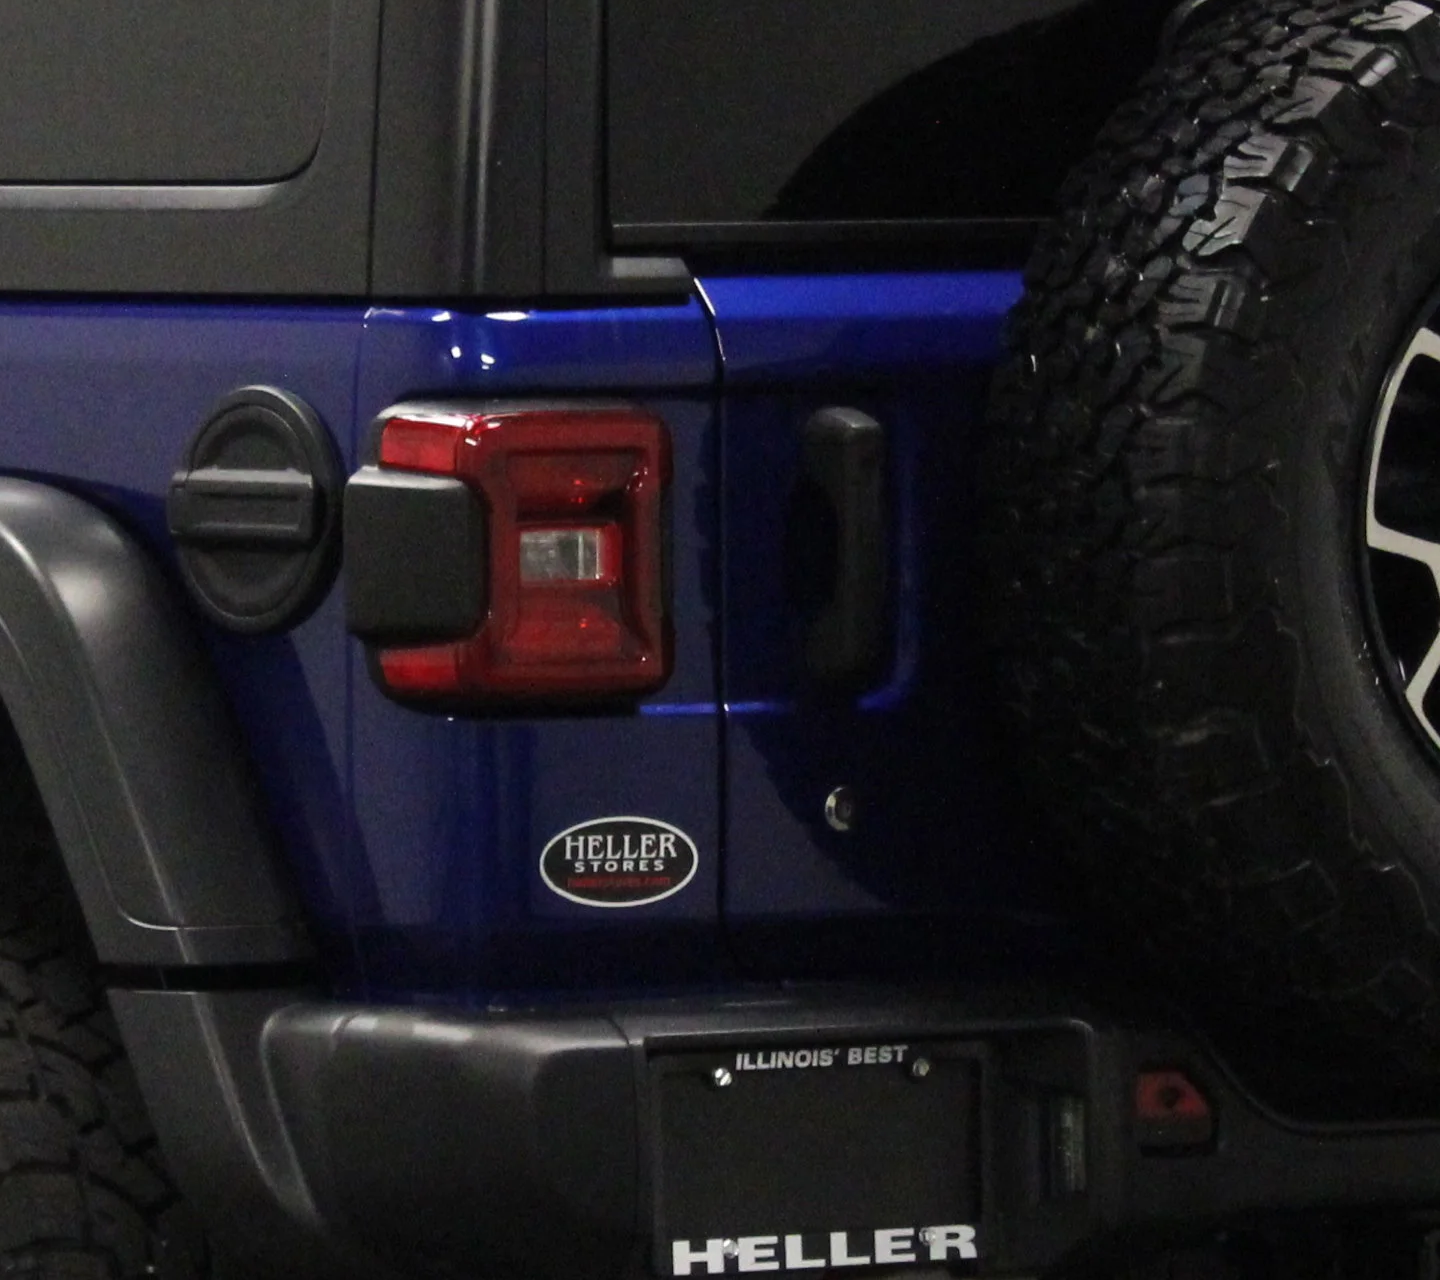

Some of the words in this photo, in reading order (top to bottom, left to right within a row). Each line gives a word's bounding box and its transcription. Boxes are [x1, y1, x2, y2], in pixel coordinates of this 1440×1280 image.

[564, 833, 677, 860] HELLER
[574, 860, 665, 873] STORES
[847, 1044, 909, 1066] BEST
[671, 1223, 979, 1277] HELLER
